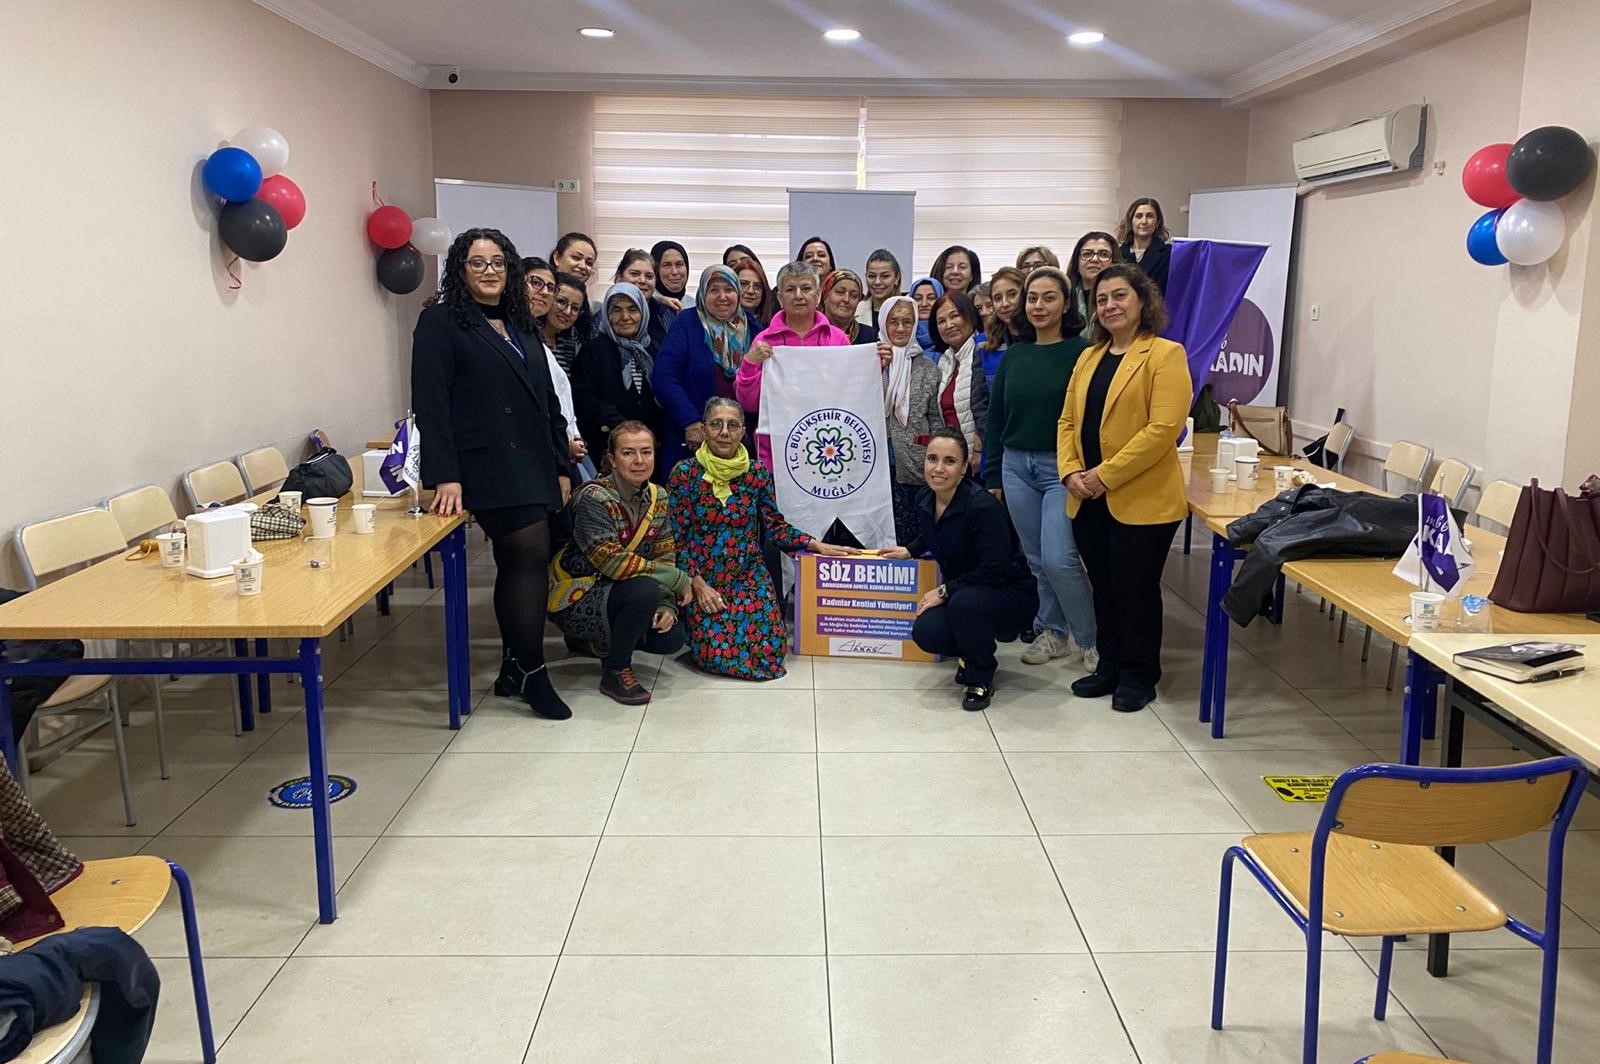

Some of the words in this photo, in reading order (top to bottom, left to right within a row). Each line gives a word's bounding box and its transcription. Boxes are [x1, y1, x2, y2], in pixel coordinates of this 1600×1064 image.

[790, 411, 841, 449] BÜYÜKŞEHİR
[844, 415, 872, 465] BELEDİYESİ
[790, 453, 800, 472] T.C.
[811, 483, 855, 497] MUĞLA
[819, 560, 851, 583] SÖZ
[854, 563, 916, 586] BENİM!
[822, 598, 851, 607] Kadınlar
[852, 600, 877, 608] Kentini
[877, 601, 912, 611] Yönetiyor!
